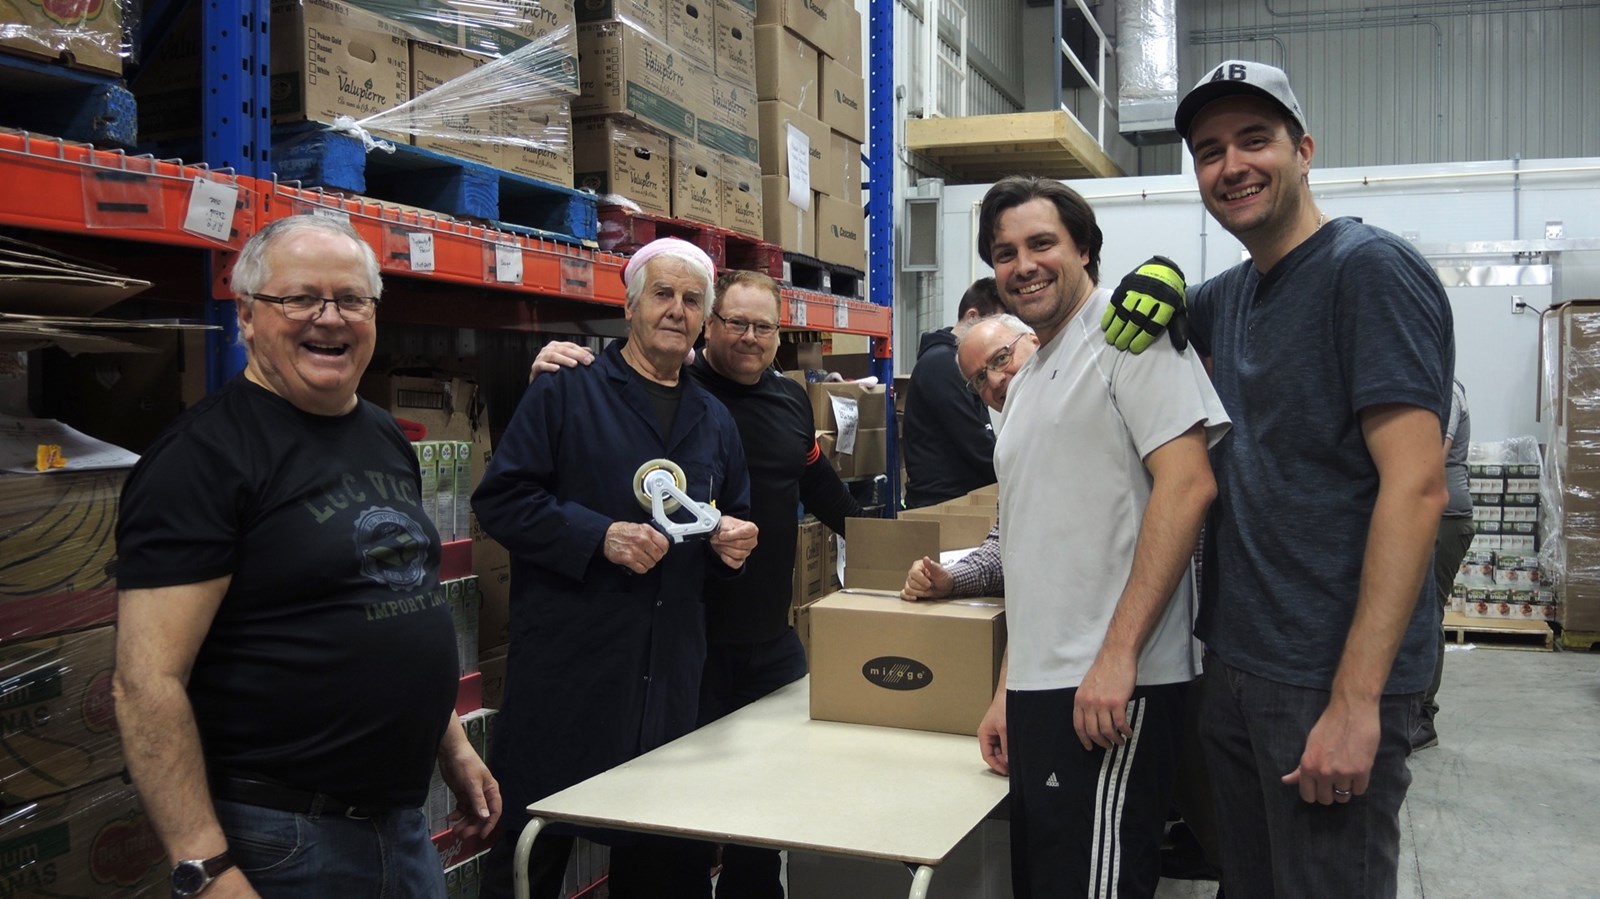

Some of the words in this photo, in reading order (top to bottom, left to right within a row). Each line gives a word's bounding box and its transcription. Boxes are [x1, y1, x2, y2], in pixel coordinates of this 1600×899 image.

[1210, 64, 1247, 82] 46
[338, 75, 387, 105] Valupierre
[840, 227, 857, 241] Cascades
[364, 594, 427, 621] IMPORT
[870, 665, 925, 681] mirage
